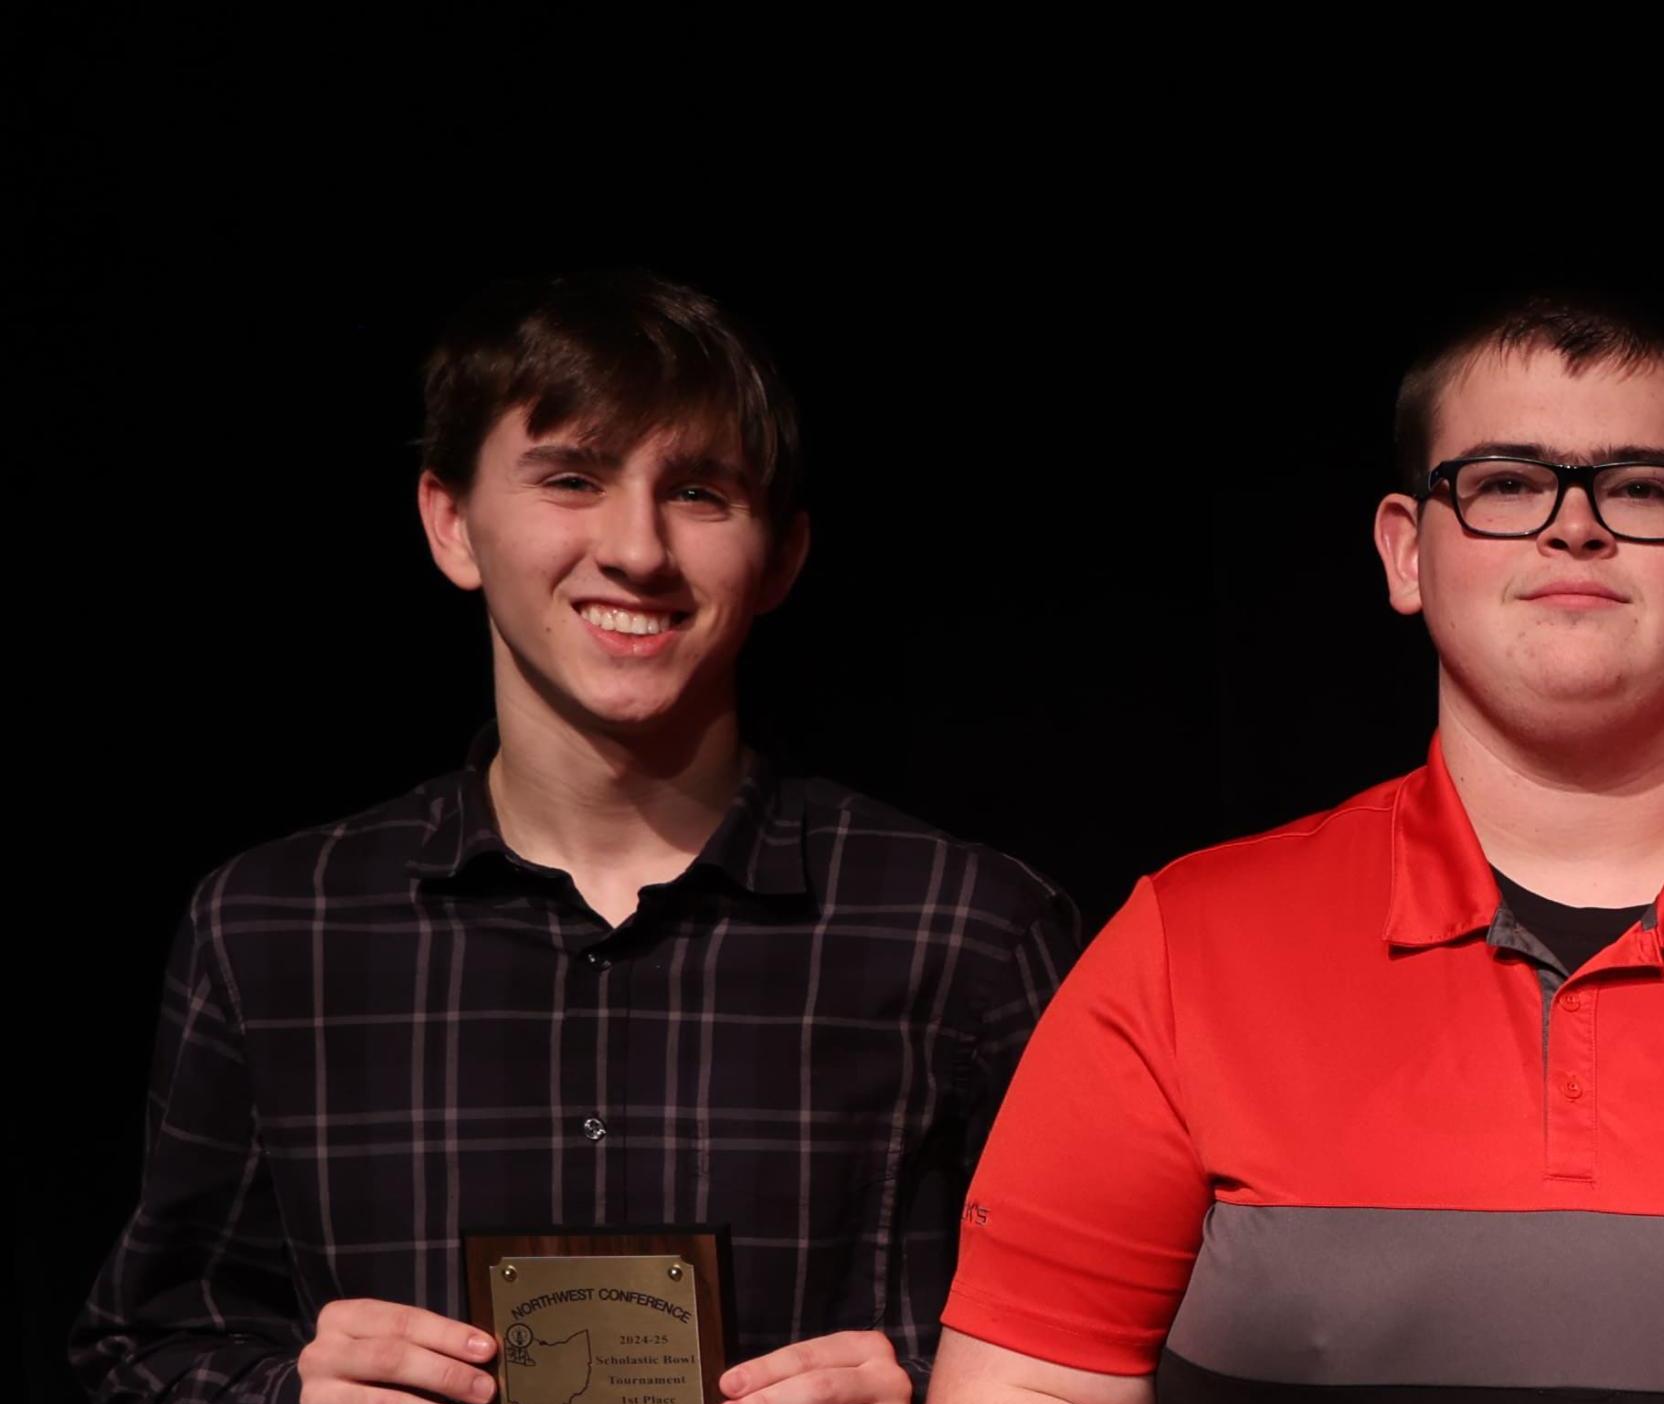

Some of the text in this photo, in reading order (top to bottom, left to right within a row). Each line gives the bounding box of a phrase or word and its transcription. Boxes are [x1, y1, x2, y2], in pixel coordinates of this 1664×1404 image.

[511, 1288, 692, 1324] NORTHWEST CONFERENCE
[619, 1335, 669, 1345] 2024-25
[595, 1355, 695, 1365] Scholastic Bowl
[609, 1375, 686, 1385] Tournament
[621, 1395, 676, 1404] 1st Place
